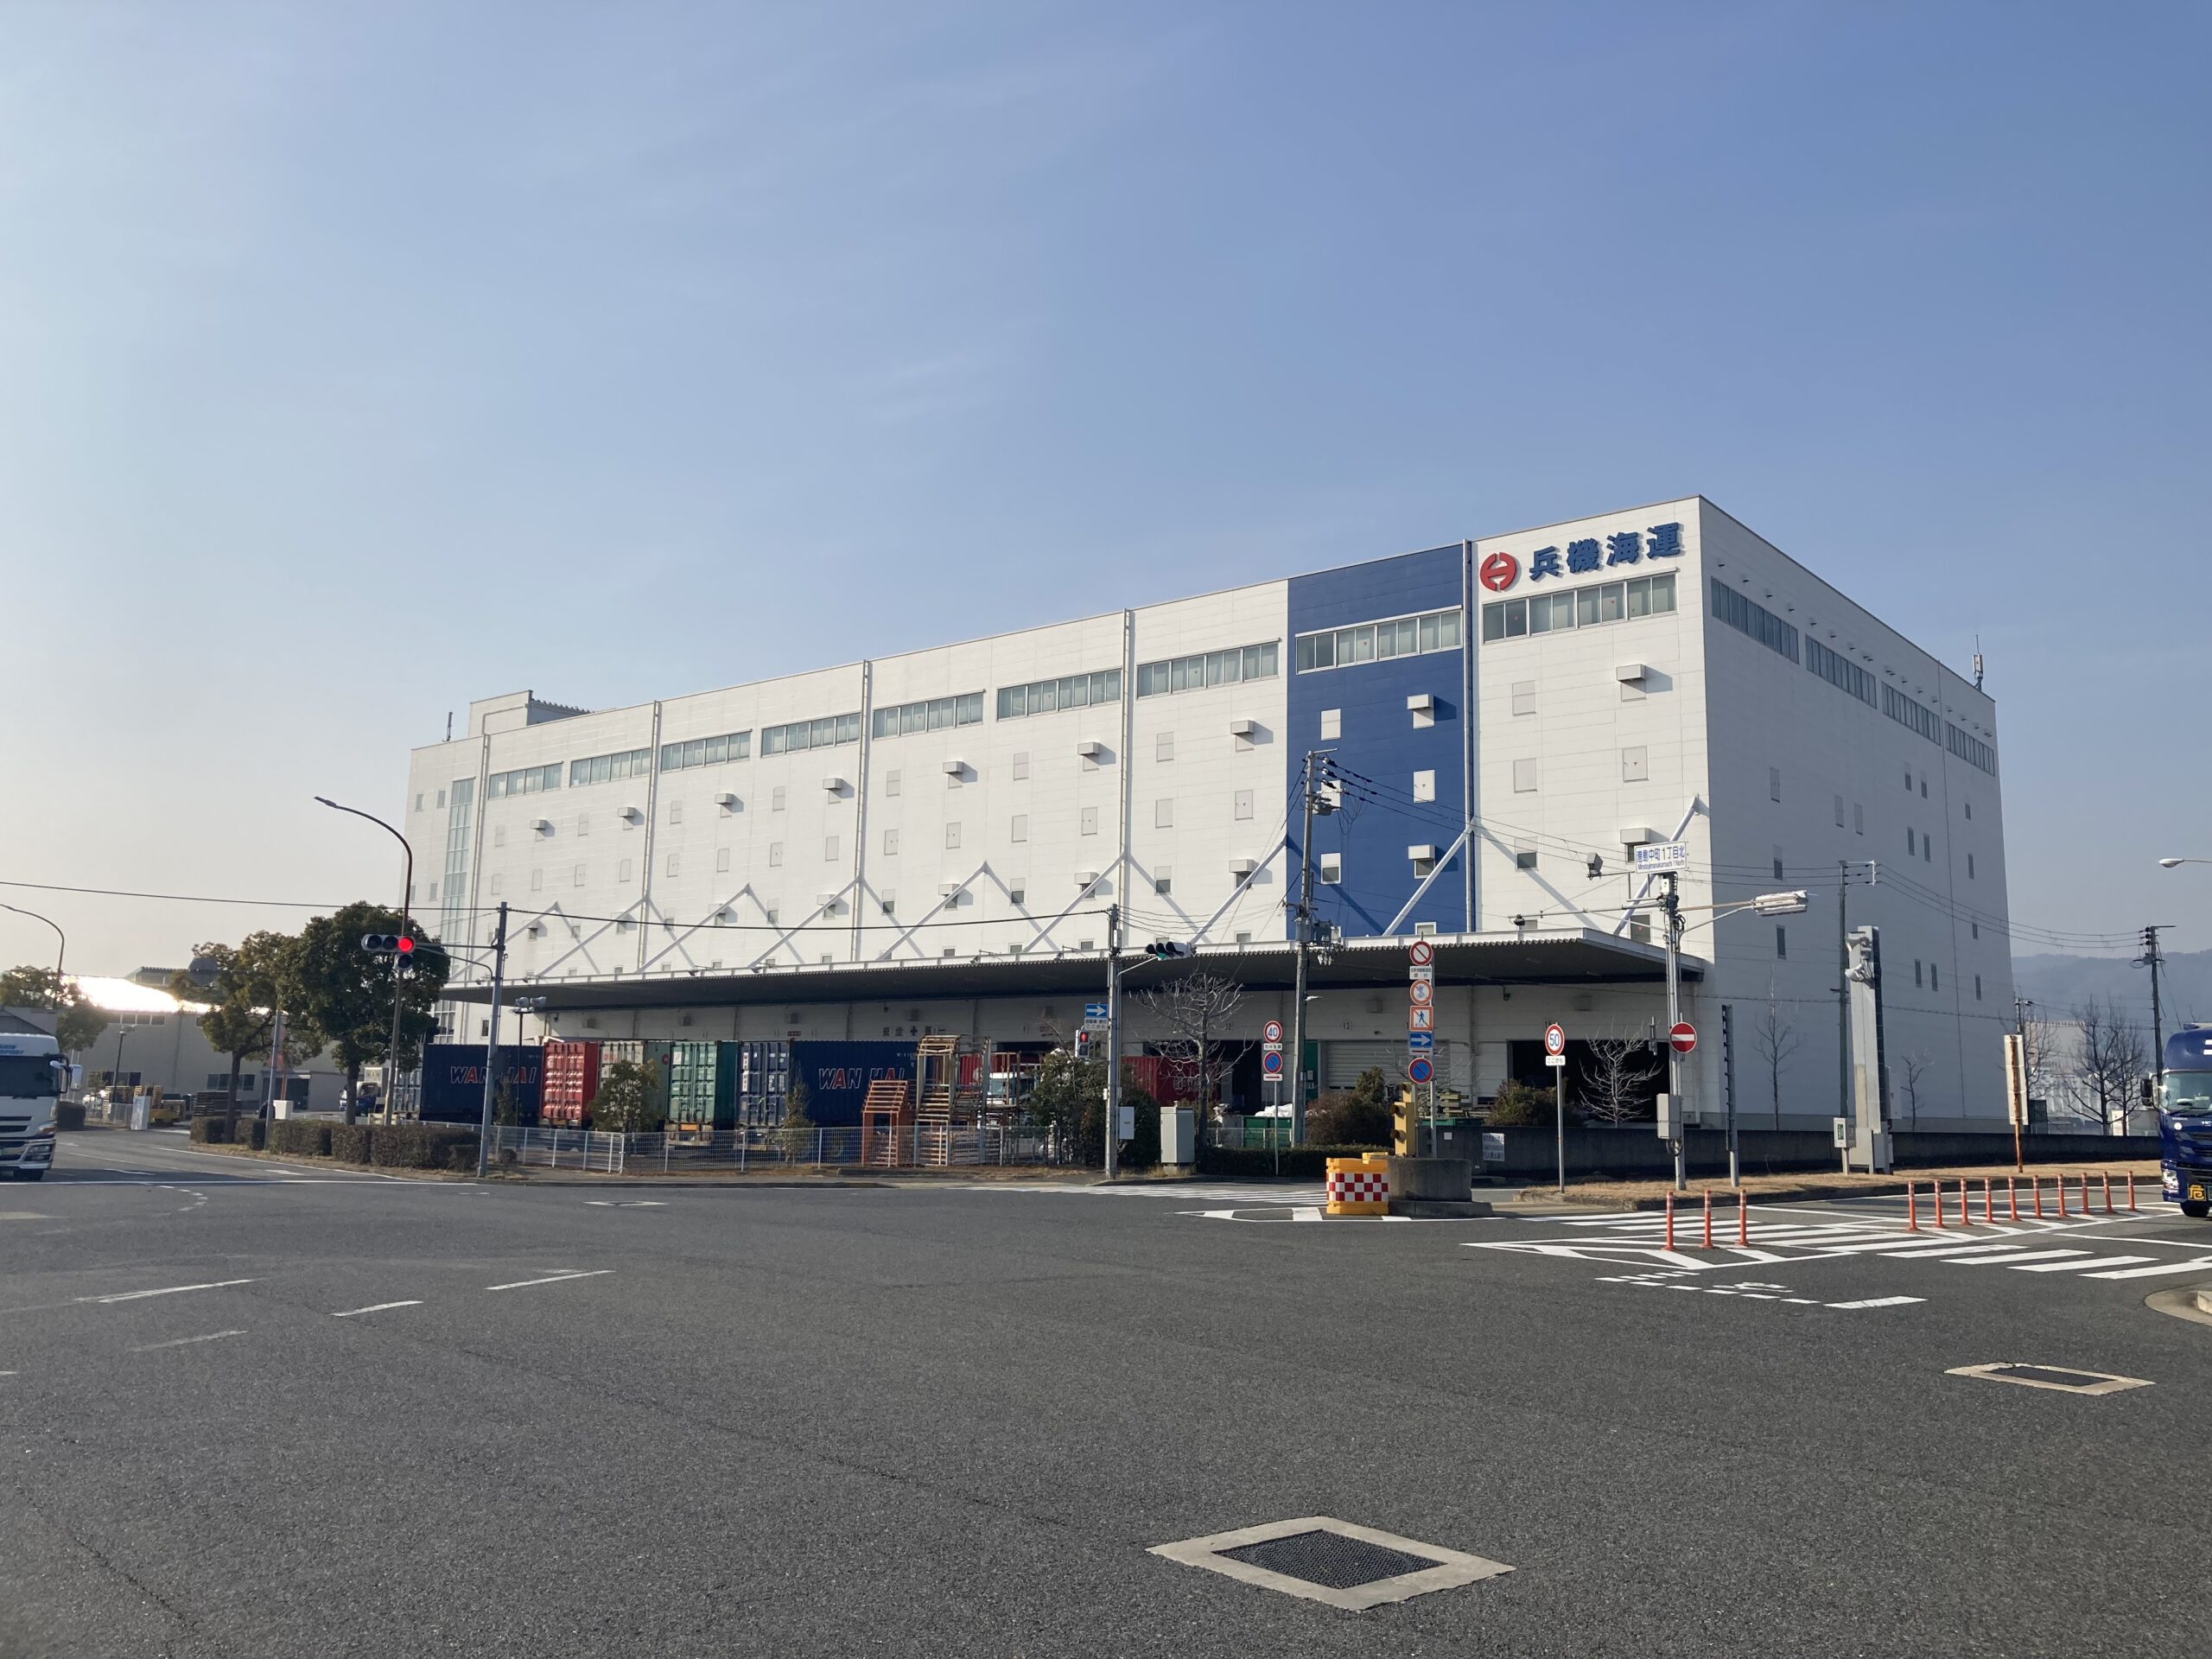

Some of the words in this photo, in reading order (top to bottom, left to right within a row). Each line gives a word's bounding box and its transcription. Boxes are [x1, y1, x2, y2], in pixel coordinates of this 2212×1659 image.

[1529, 522, 1681, 581] 兵機海運
[1268, 1027, 1278, 1037] 40
[1549, 1033, 1560, 1046] 50
[818, 1068, 862, 1090] WAN
[2190, 1184, 2204, 1200] 危
